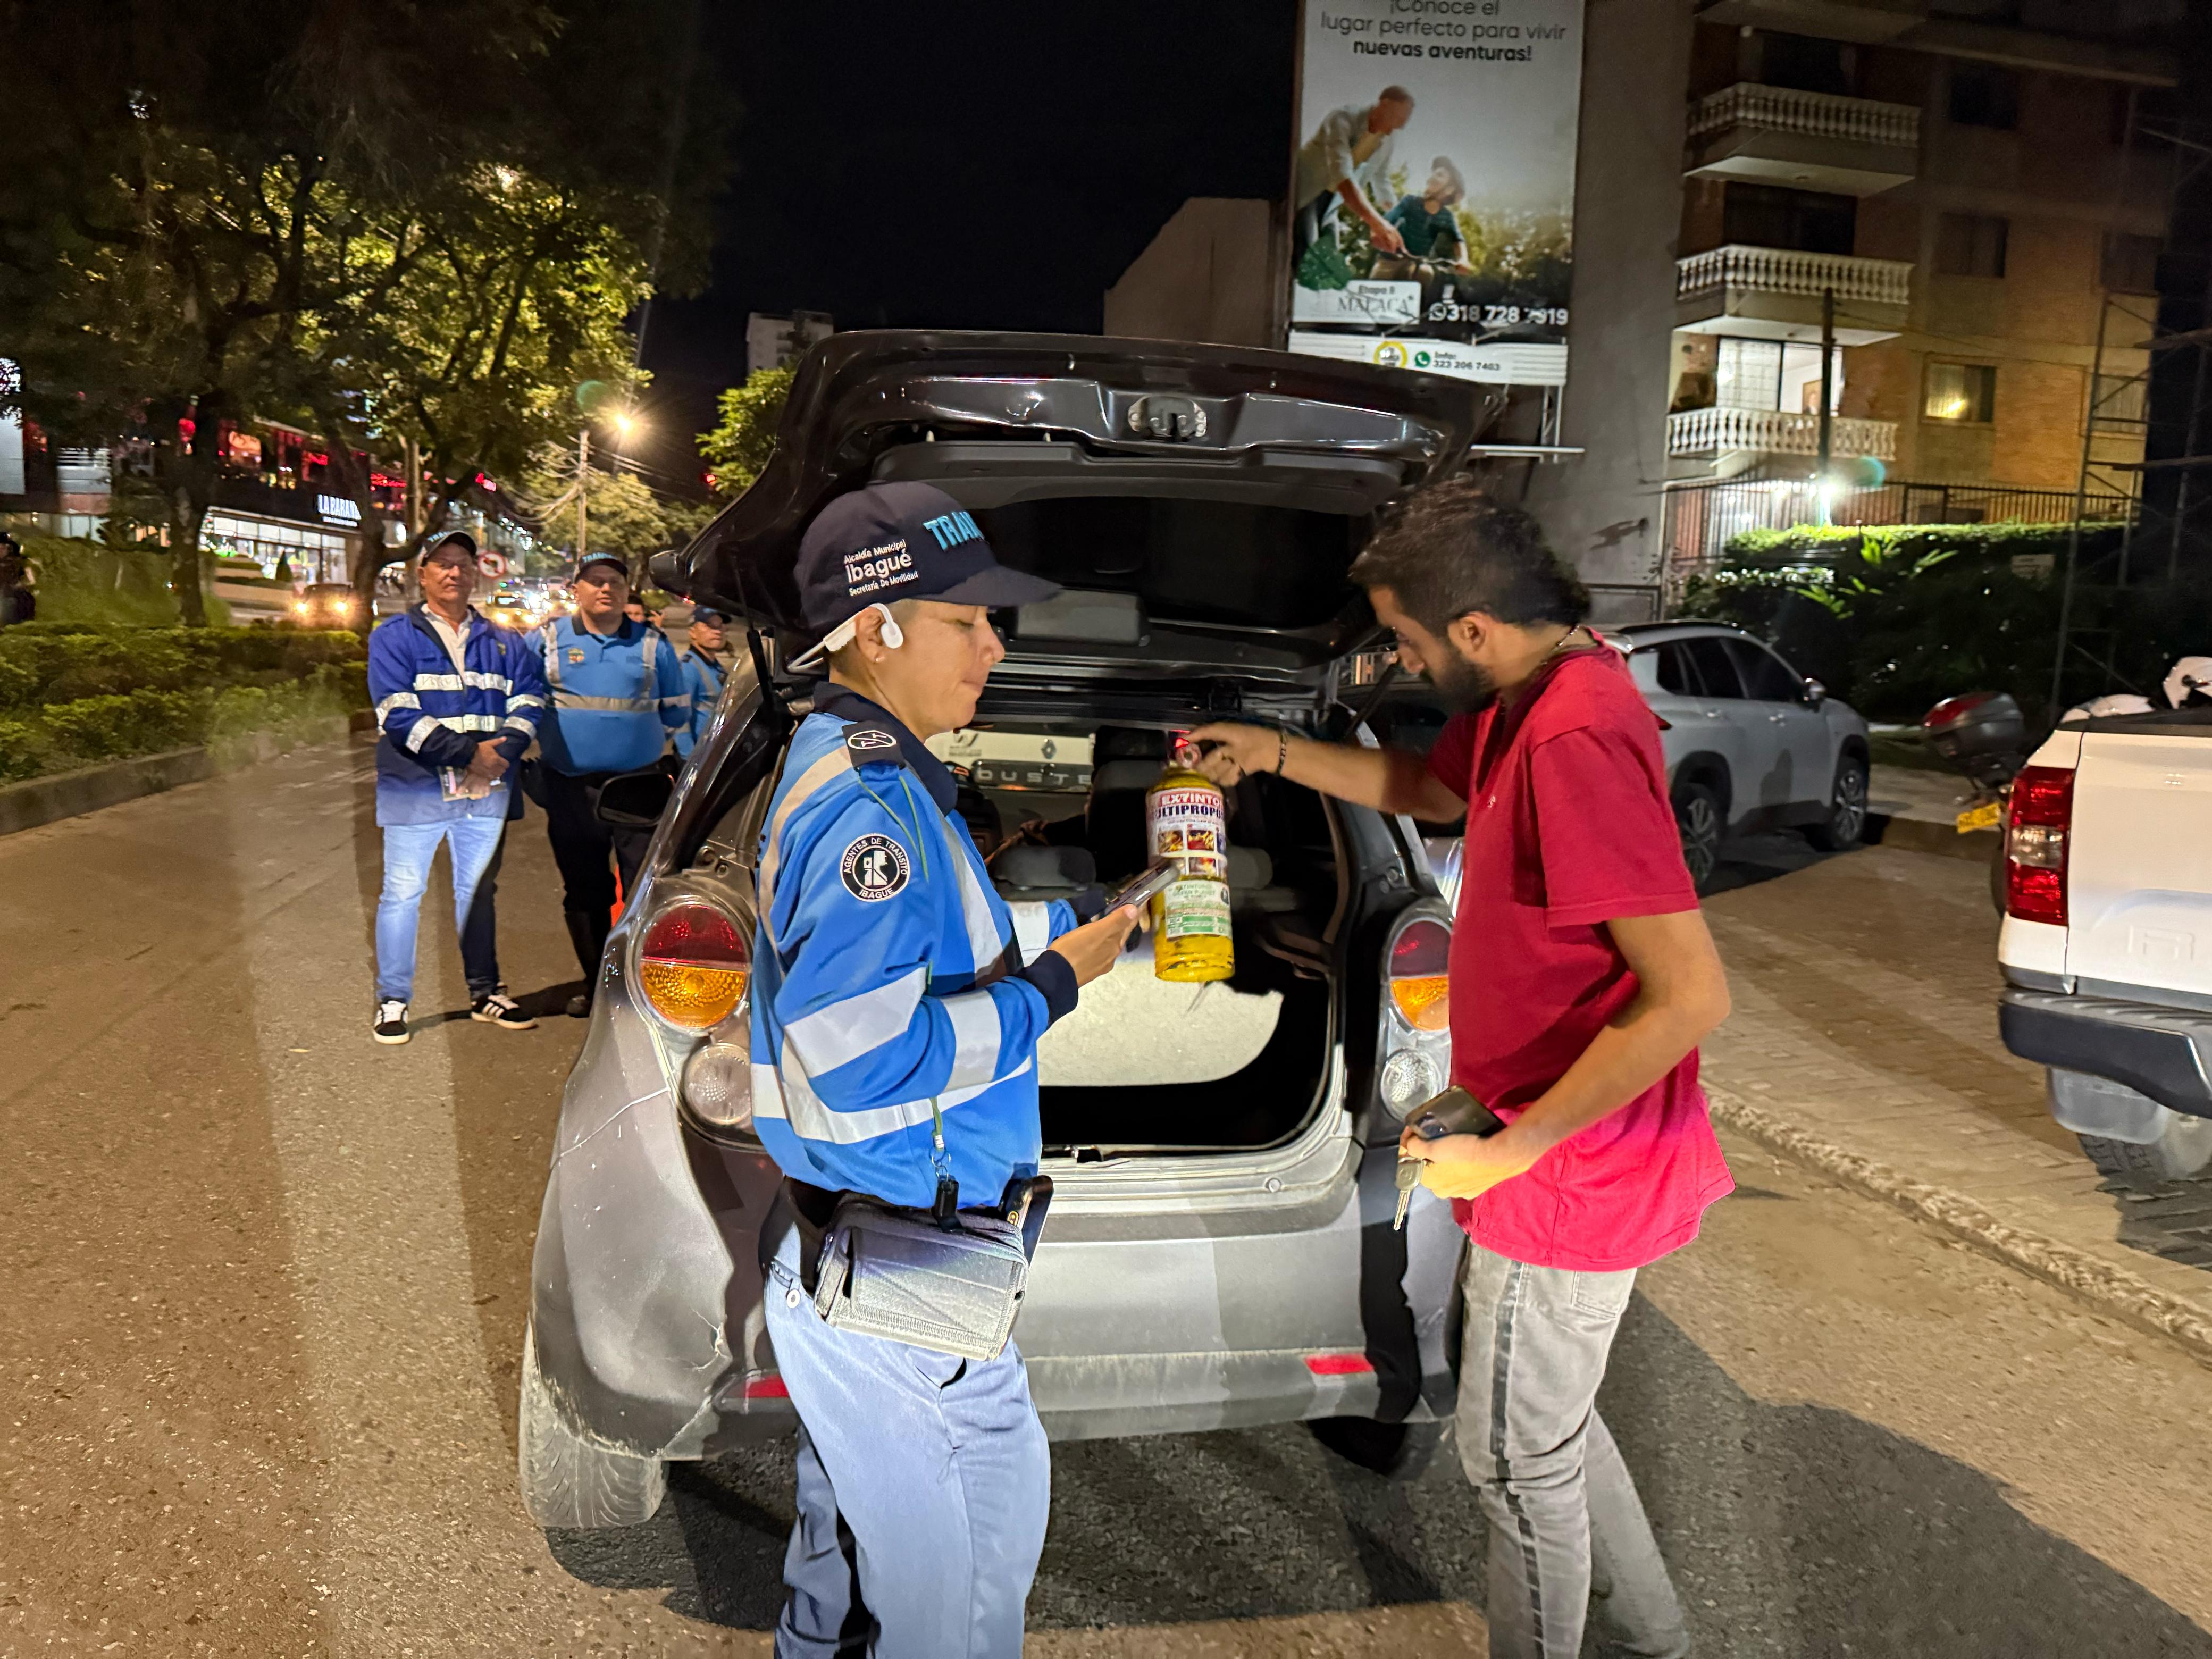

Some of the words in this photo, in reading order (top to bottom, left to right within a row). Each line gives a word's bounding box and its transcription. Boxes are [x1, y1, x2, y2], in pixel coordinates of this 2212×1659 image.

[1481, 0, 1499, 15] el
[1320, 11, 1373, 35] lugar
[1379, 17, 1467, 39] perfecto
[1472, 23, 1520, 41] para
[1526, 23, 1566, 40] vivir
[1353, 40, 1422, 57] nuevas
[1428, 44, 1532, 61] aventuras!
[1446, 304, 1481, 322] 318
[1484, 305, 1520, 323] 728
[843, 548, 873, 564] Alcaldía
[873, 539, 907, 556] Municipal
[845, 548, 912, 583] Ibagué
[849, 580, 879, 597] Secretaría
[879, 579, 890, 588] De
[889, 571, 919, 585] Movilidad
[843, 839, 868, 874] AGENTES
[885, 840, 908, 875] TRANSITO
[859, 887, 895, 899] IBAGUE
